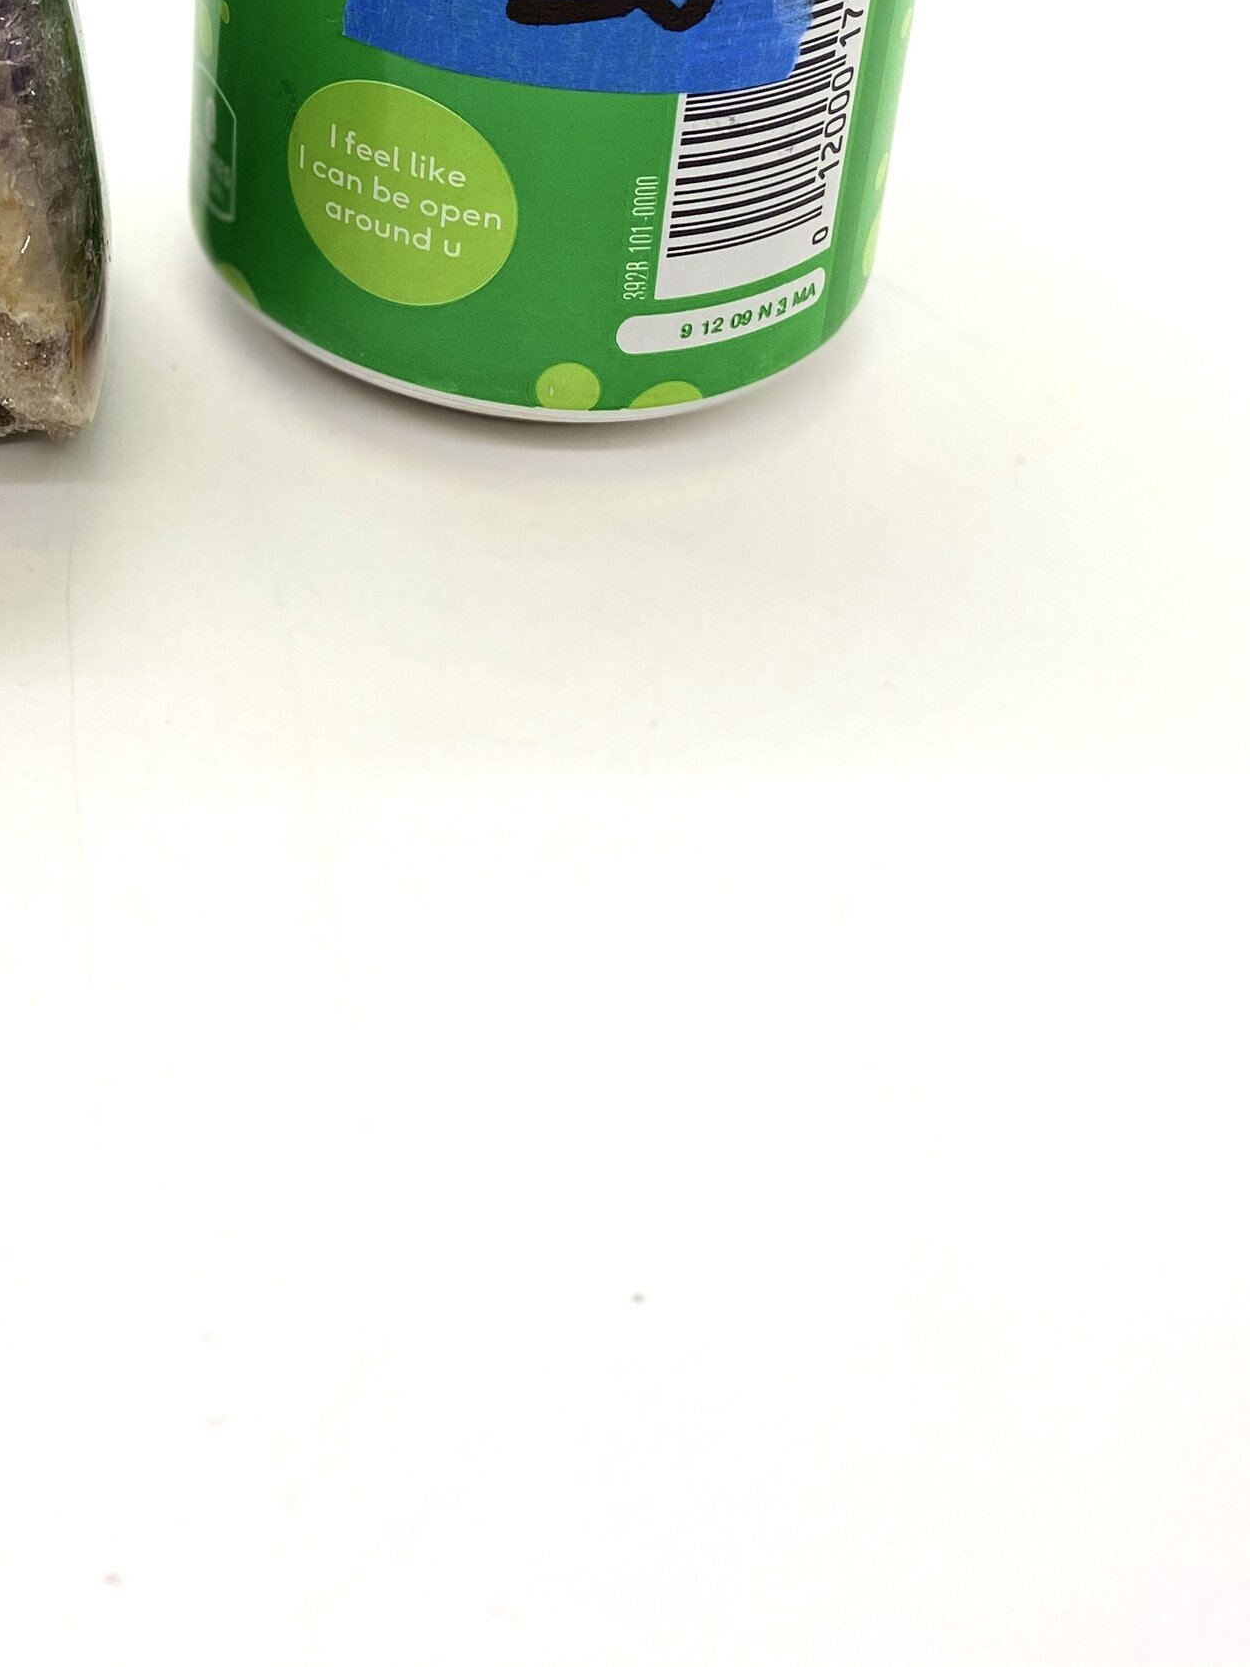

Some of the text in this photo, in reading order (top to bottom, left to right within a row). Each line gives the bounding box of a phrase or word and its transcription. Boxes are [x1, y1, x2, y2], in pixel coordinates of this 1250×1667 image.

[818, 66, 854, 179] 12000
[330, 123, 466, 187] I feel like
[300, 144, 502, 230] I can be open
[325, 201, 461, 257] around u
[812, 225, 828, 245] 0
[680, 323, 693, 339] 9
[701, 317, 725, 335] 12
[730, 309, 753, 329] 09
[757, 302, 773, 321] N
[792, 282, 816, 307] MA
